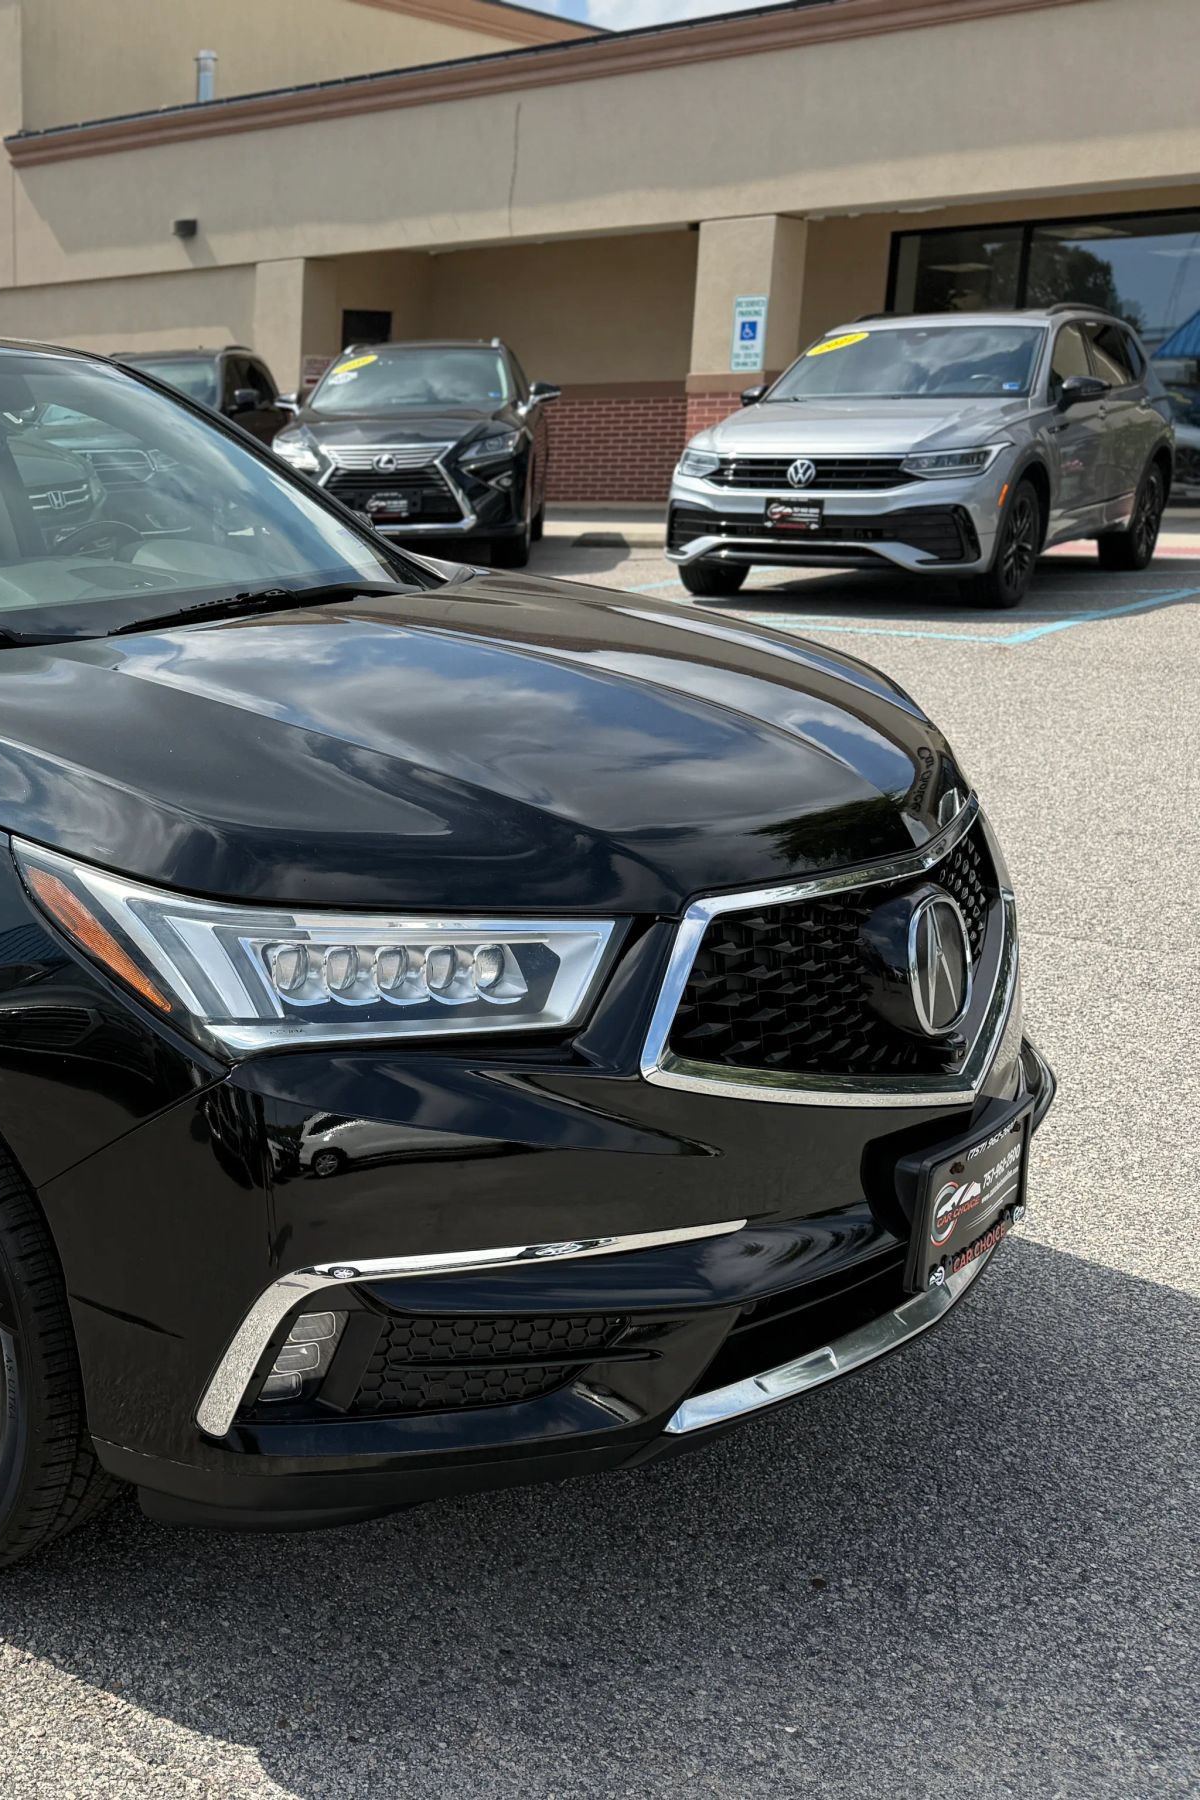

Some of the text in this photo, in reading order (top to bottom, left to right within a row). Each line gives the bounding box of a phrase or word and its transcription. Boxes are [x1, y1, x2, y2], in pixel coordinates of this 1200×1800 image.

[936, 1195, 981, 1228] CAR CHOICE
[953, 1221, 1005, 1273] CAR CHOICE
